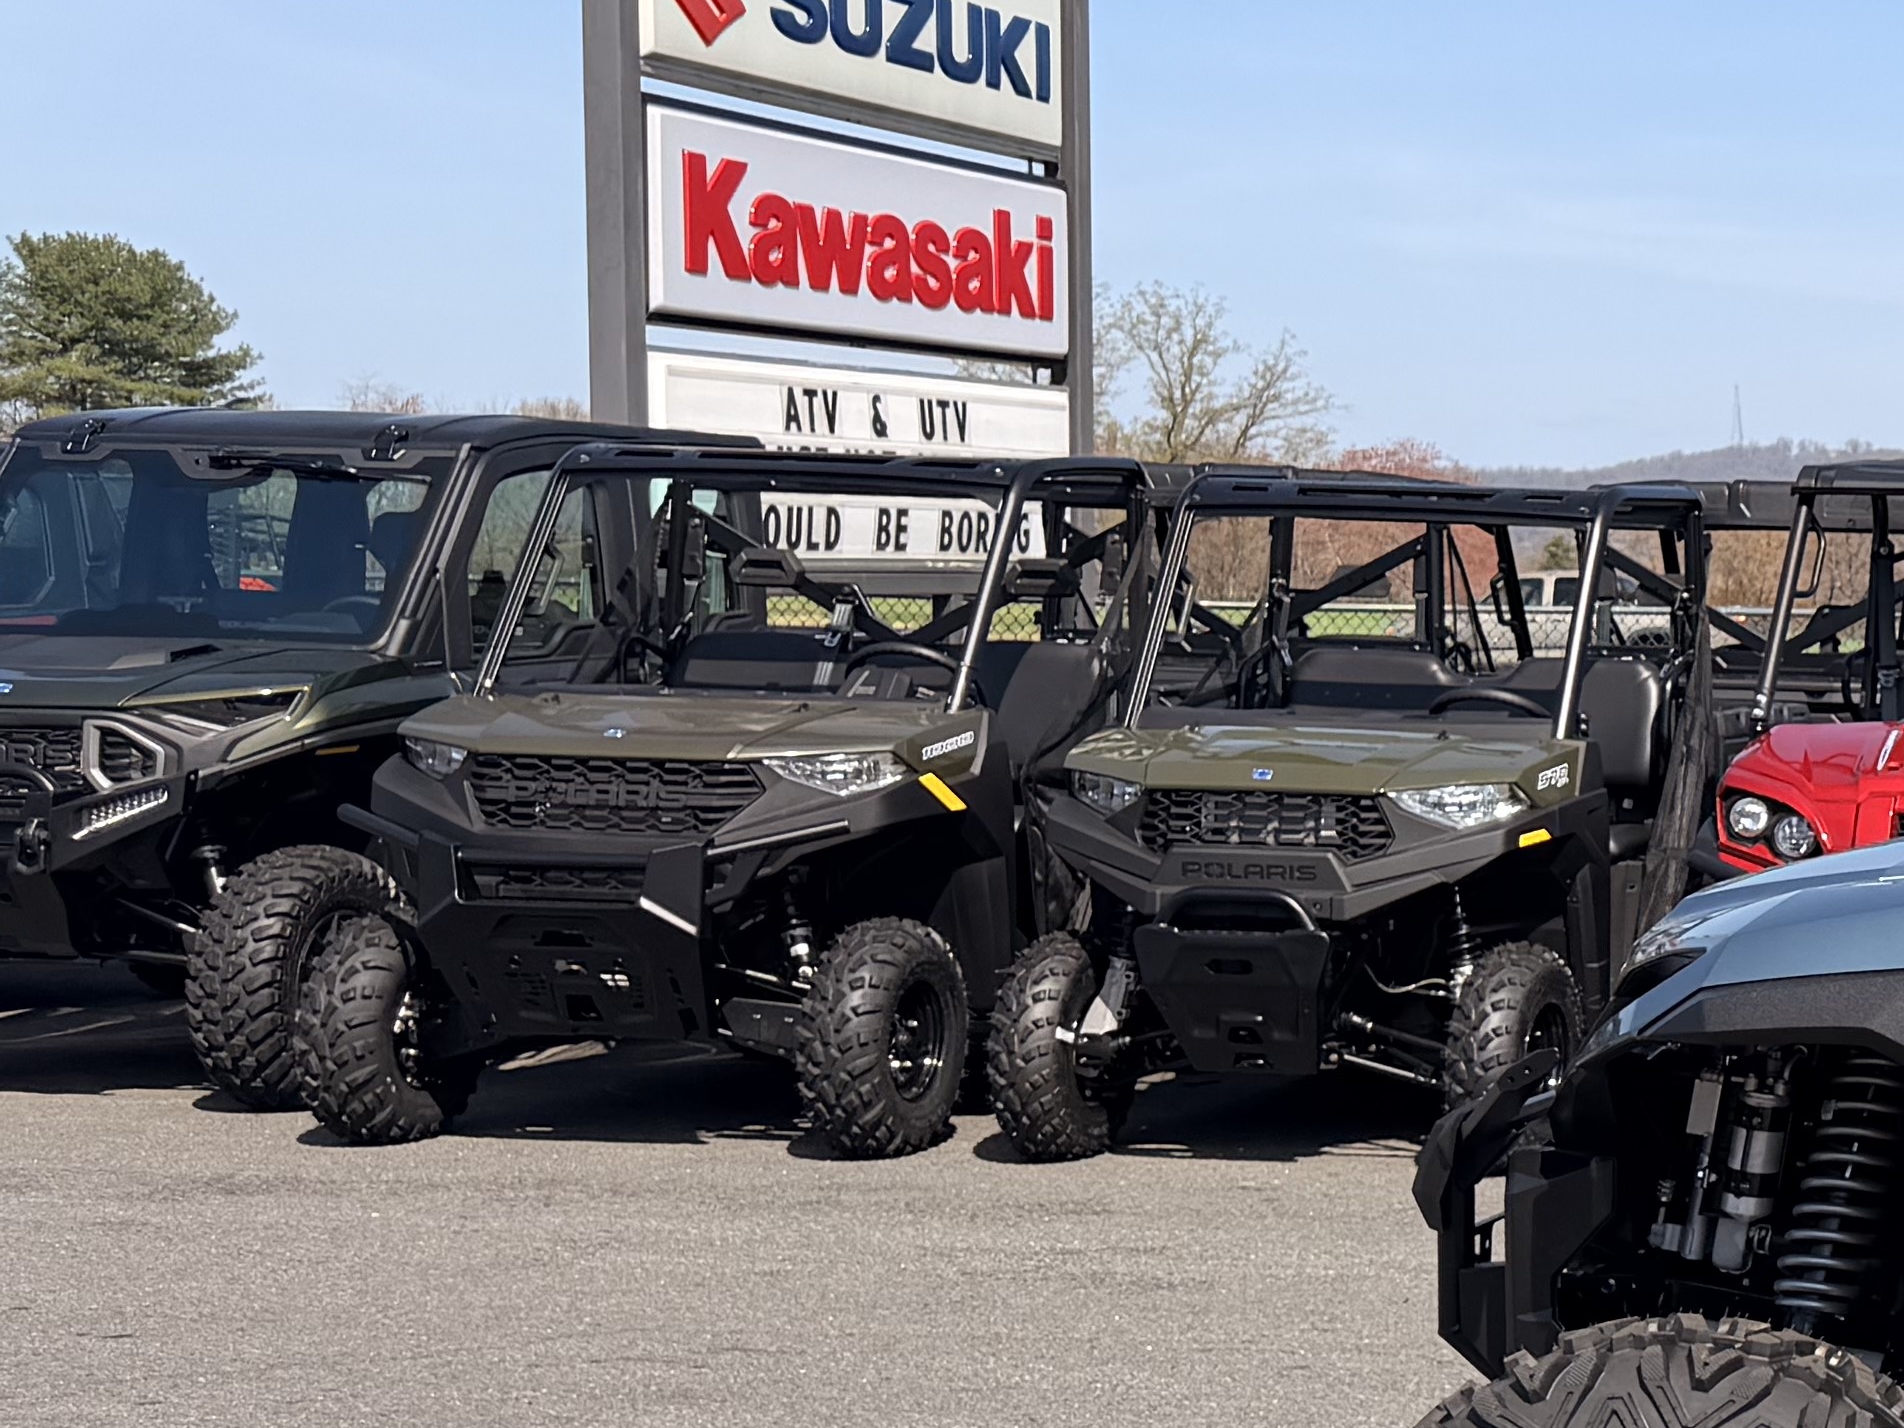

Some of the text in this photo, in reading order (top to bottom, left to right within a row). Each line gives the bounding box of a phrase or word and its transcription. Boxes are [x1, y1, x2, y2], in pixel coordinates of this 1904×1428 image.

[682, 149, 1053, 322] Kawasaki
[784, 387, 968, 443] ATV & UTV
[763, 504, 1030, 554] OULD BE BORG
[1181, 861, 1317, 881] POLARIS
